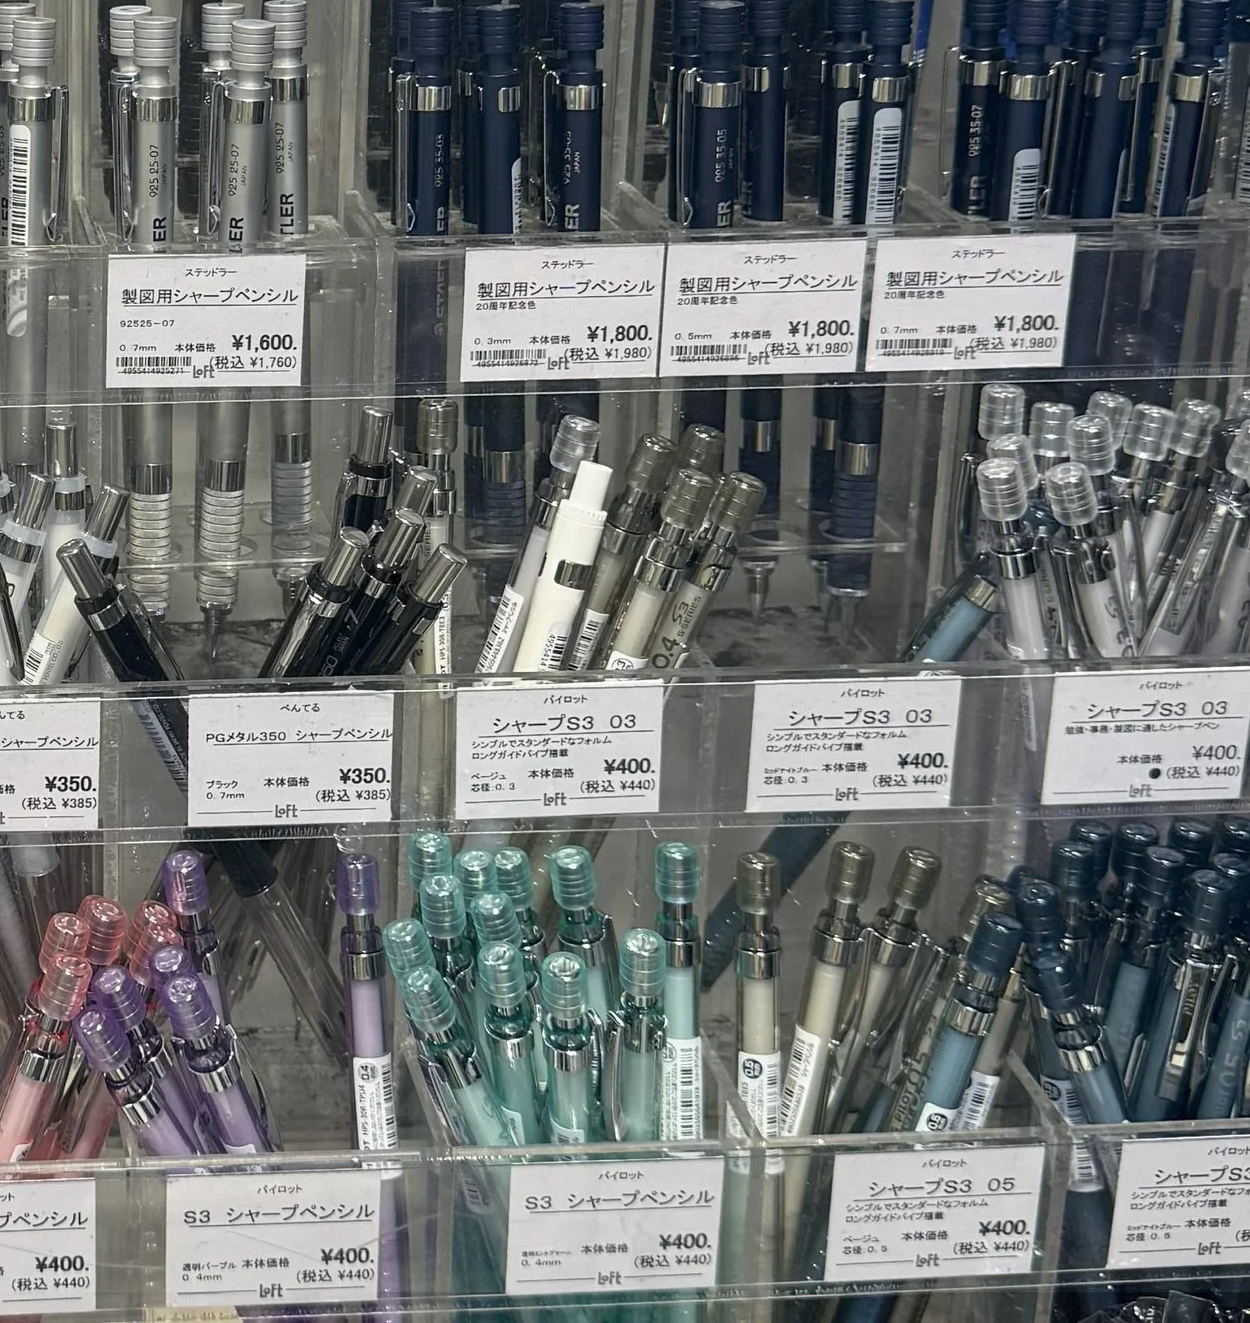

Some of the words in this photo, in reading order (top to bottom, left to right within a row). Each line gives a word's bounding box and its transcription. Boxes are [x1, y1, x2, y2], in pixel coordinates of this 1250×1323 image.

[679, 274, 858, 293] 製図用シャープペンシル
[886, 268, 1064, 287] 製図用シャープペンシル
[121, 287, 299, 304] 製図用シャープペンシル
[477, 279, 655, 298] 製図用シャープペンシル
[1010, 336, 1057, 349] ¥1,980)
[789, 708, 890, 726] シャープS3
[1088, 700, 1187, 719] シャープS3
[206, 732, 286, 743] PGメタル350
[295, 724, 394, 741] シャープペンシル
[493, 714, 594, 734] シャープS3
[1, 736, 99, 748] シャープペンシル
[206, 780, 238, 789] ブラック
[869, 1177, 972, 1197] シャープS3
[525, 1196, 552, 1210] S3
[568, 1190, 715, 1209] シャープペンシル
[184, 1210, 210, 1224] S3
[227, 1204, 375, 1223] シャープペンシル
[991, 1240, 1029, 1254] ¥440)
